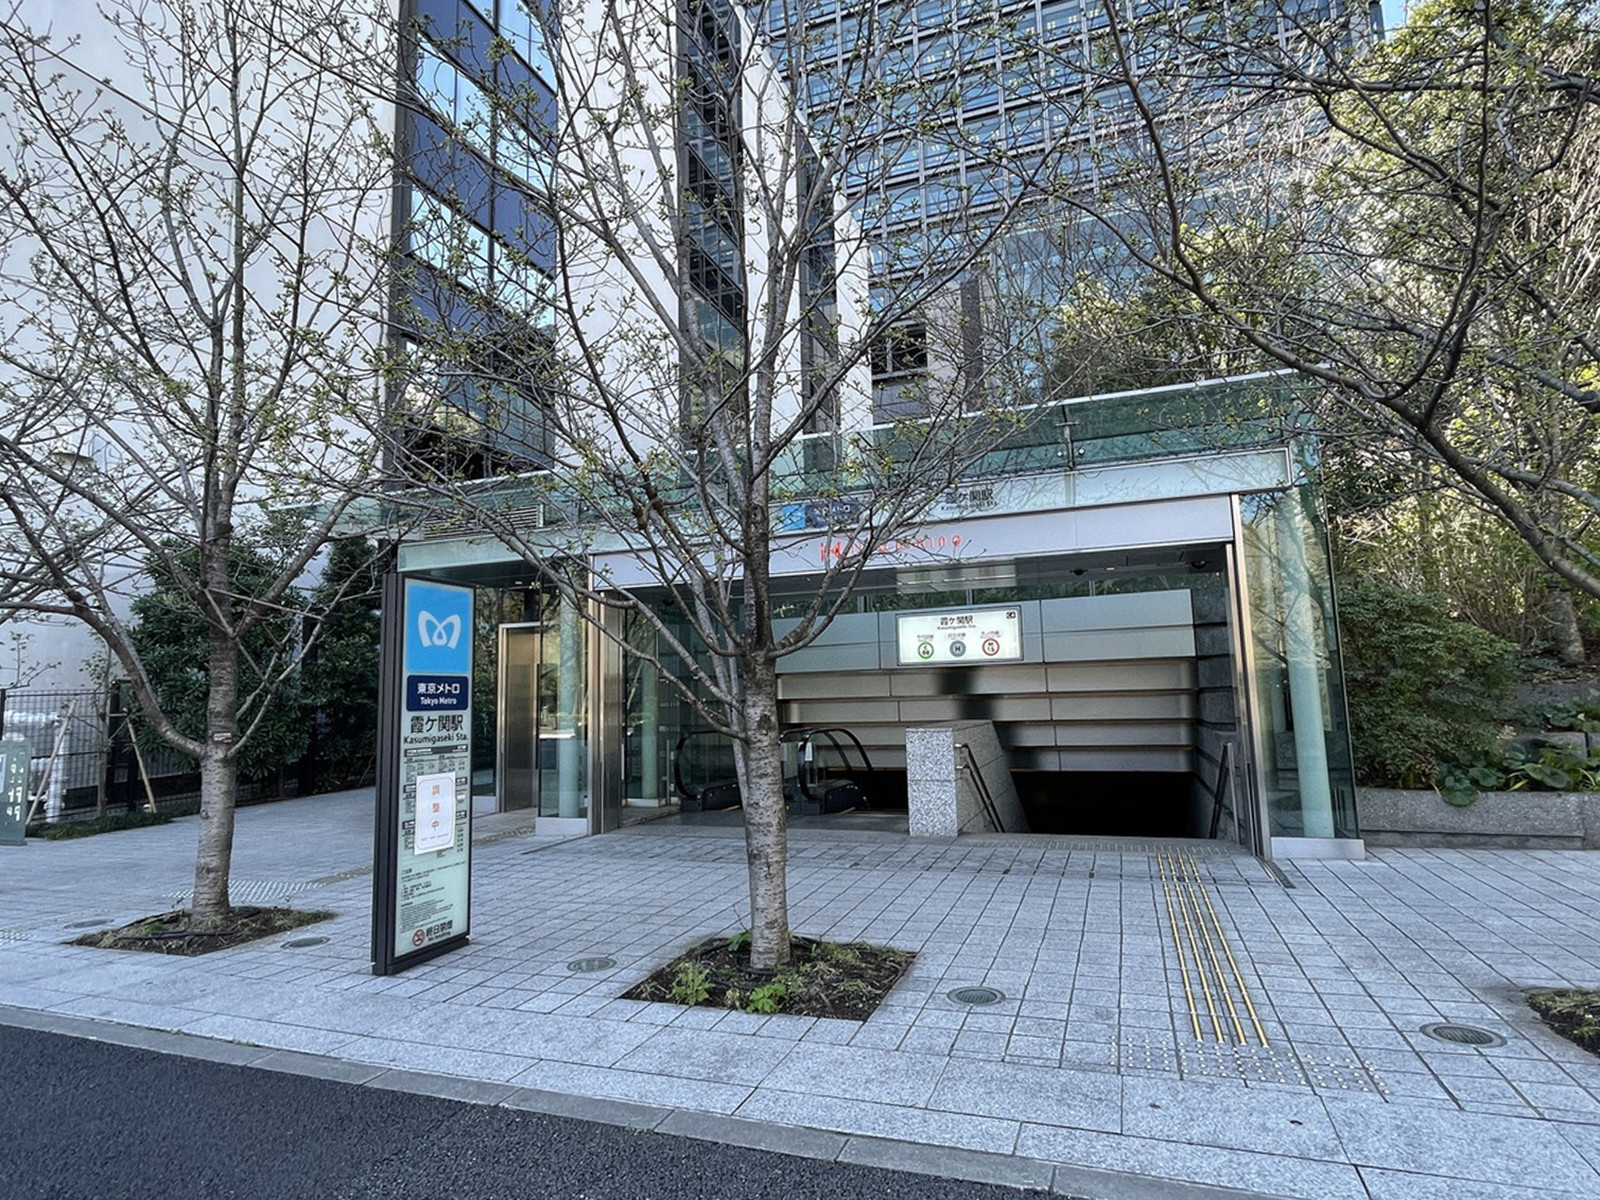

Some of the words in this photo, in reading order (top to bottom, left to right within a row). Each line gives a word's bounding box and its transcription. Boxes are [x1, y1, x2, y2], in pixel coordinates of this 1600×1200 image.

[417, 682, 460, 695] 東京メトロ
[420, 697, 438, 706] Tokyo
[439, 697, 457, 705] Metro
[404, 733, 454, 744] Kasumigaseki
[456, 732, 468, 741] Sta.
